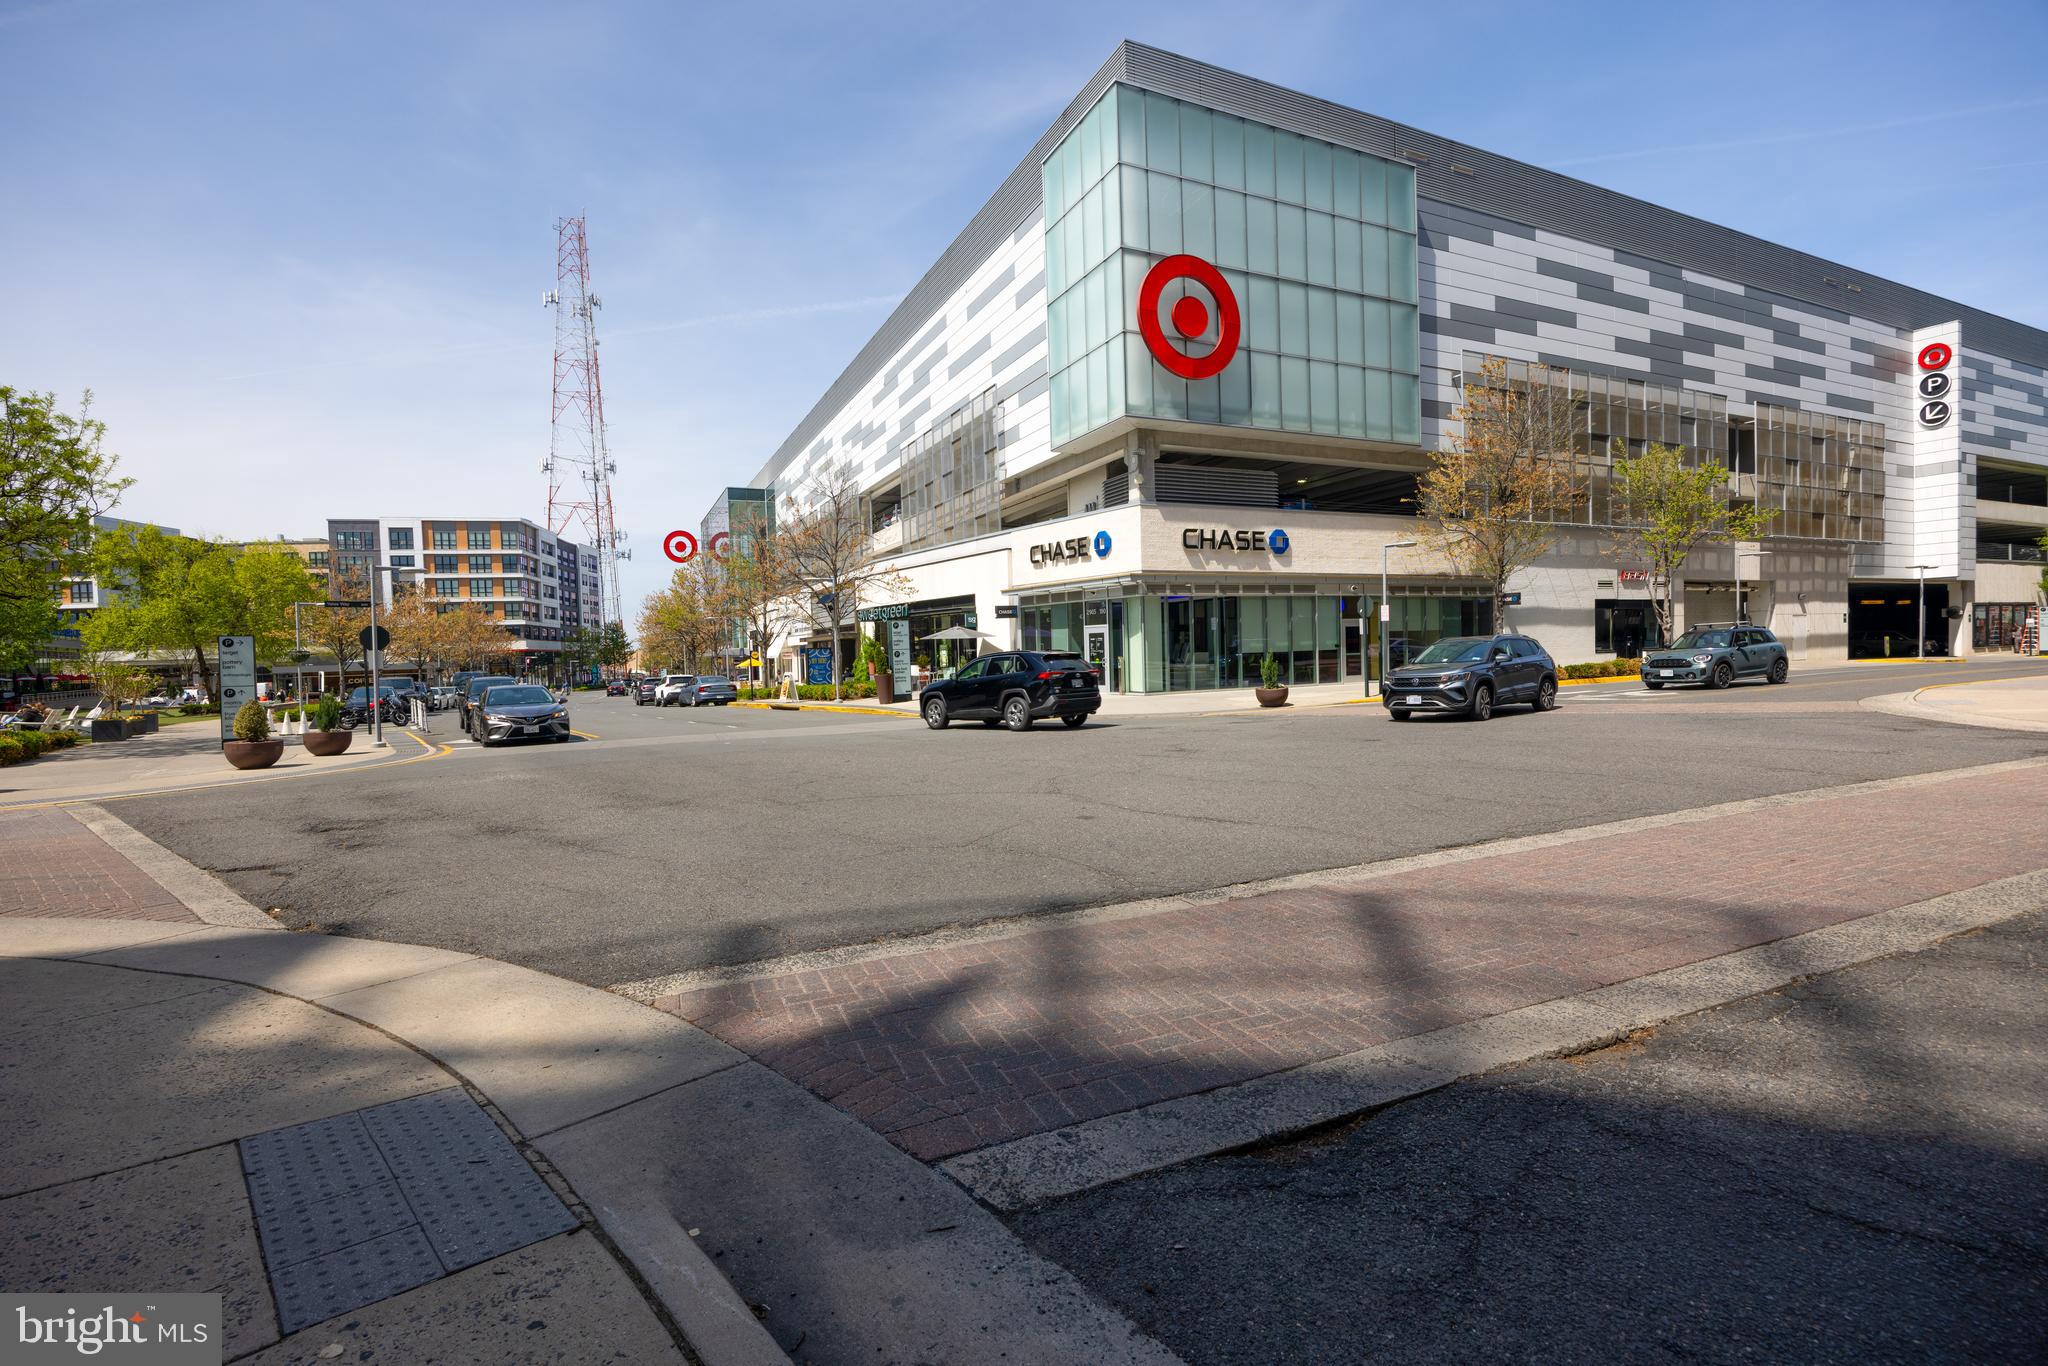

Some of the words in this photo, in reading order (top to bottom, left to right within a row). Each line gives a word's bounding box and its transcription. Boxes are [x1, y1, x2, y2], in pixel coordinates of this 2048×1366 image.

[1927, 377, 1943, 392] P
[1183, 528, 1266, 551] CHASE
[1030, 536, 1089, 564] CHASE
[857, 603, 908, 622] sweetgreen
[967, 616, 977, 624] sg
